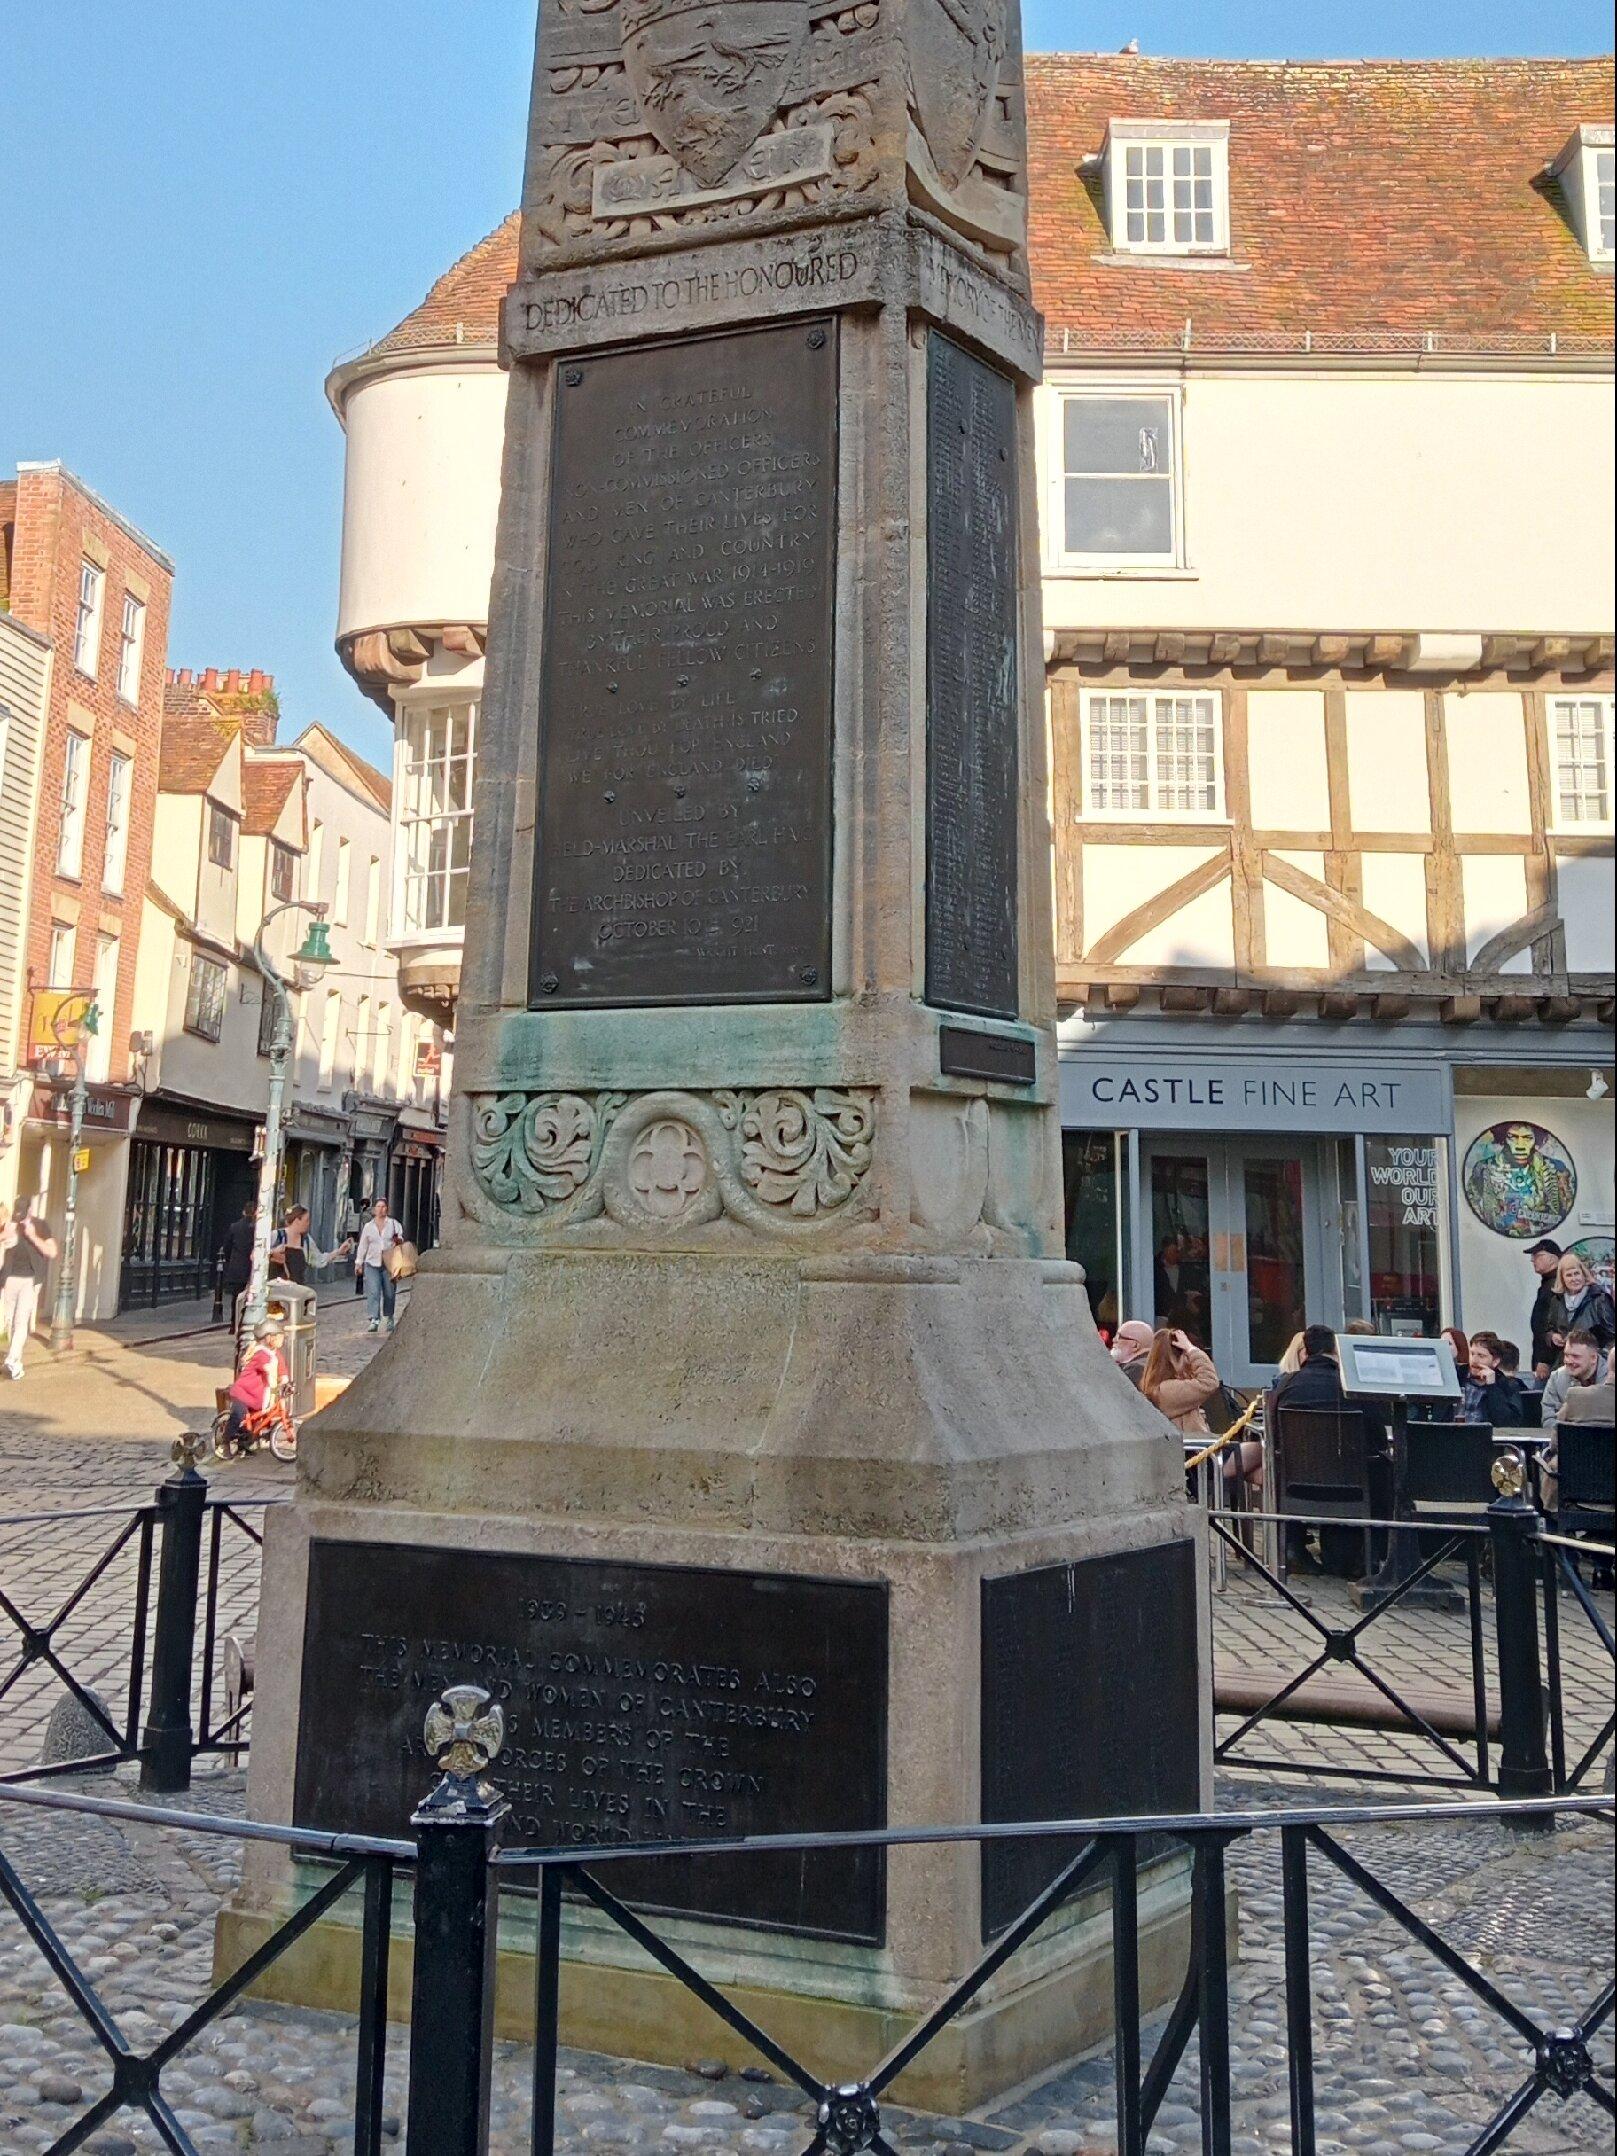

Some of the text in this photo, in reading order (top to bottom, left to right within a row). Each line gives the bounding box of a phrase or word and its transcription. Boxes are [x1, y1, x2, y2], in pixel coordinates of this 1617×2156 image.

[525, 251, 858, 332] DEDICATED TO THE HONOURED
[661, 386, 753, 411] GRATEFUL
[613, 407, 776, 443] COMMEMORATION
[613, 432, 775, 468] OF THE OFFICERS
[737, 451, 821, 476] OFFICERS
[613, 500, 649, 517] MEN
[661, 495, 684, 512] OF
[695, 478, 818, 507] CANTERBURY
[610, 522, 656, 544] GAVE
[663, 515, 716, 536] THEIR
[724, 509, 776, 530] LIVES
[782, 503, 819, 523] FOR
[667, 543, 705, 563] AND
[721, 529, 818, 557] COUNTRY
[624, 571, 682, 595] GREAT
[687, 566, 724, 586] WAR
[605, 597, 697, 621] MEMORIAL
[701, 591, 737, 610] WAS
[743, 583, 821, 607] ERECTED
[672, 619, 730, 640] PROUD
[742, 613, 780, 632] AND
[656, 645, 728, 668] FELLOW
[735, 637, 818, 661] CITIZENS
[701, 690, 736, 708] LIFE
[730, 713, 745, 729] IS
[751, 707, 799, 726] TRIED
[619, 803, 741, 828] UNVEILED BY
[685, 831, 725, 850] THE
[613, 862, 706, 883] DEDICATED
[584, 890, 679, 912] ARCHBISHOP
[681, 889, 701, 907] OF
[708, 883, 810, 906] CANTERBURY
[598, 918, 678, 941] OCTOBER
[1092, 1077, 1402, 1108] CASTLE FINE ART
[1387, 1147, 1438, 1167] YOUR
[595, 1600, 647, 1629] 1945
[360, 1632, 818, 1698] THIS MEMORIAL COMMEMORATES ALSO
[359, 1664, 400, 1688] THE
[526, 1682, 605, 1710] WOMEN
[618, 1692, 645, 1714] OF
[658, 1697, 816, 1732] CANTERBURY
[532, 1716, 632, 1747] MEMBERS
[646, 1728, 673, 1751] OF
[685, 1731, 729, 1759] THE
[581, 1755, 609, 1776] OF
[620, 1758, 665, 1785] THE
[679, 1767, 768, 1793] CROWN
[493, 1777, 728, 1827] THEIR LIVES IN THE
